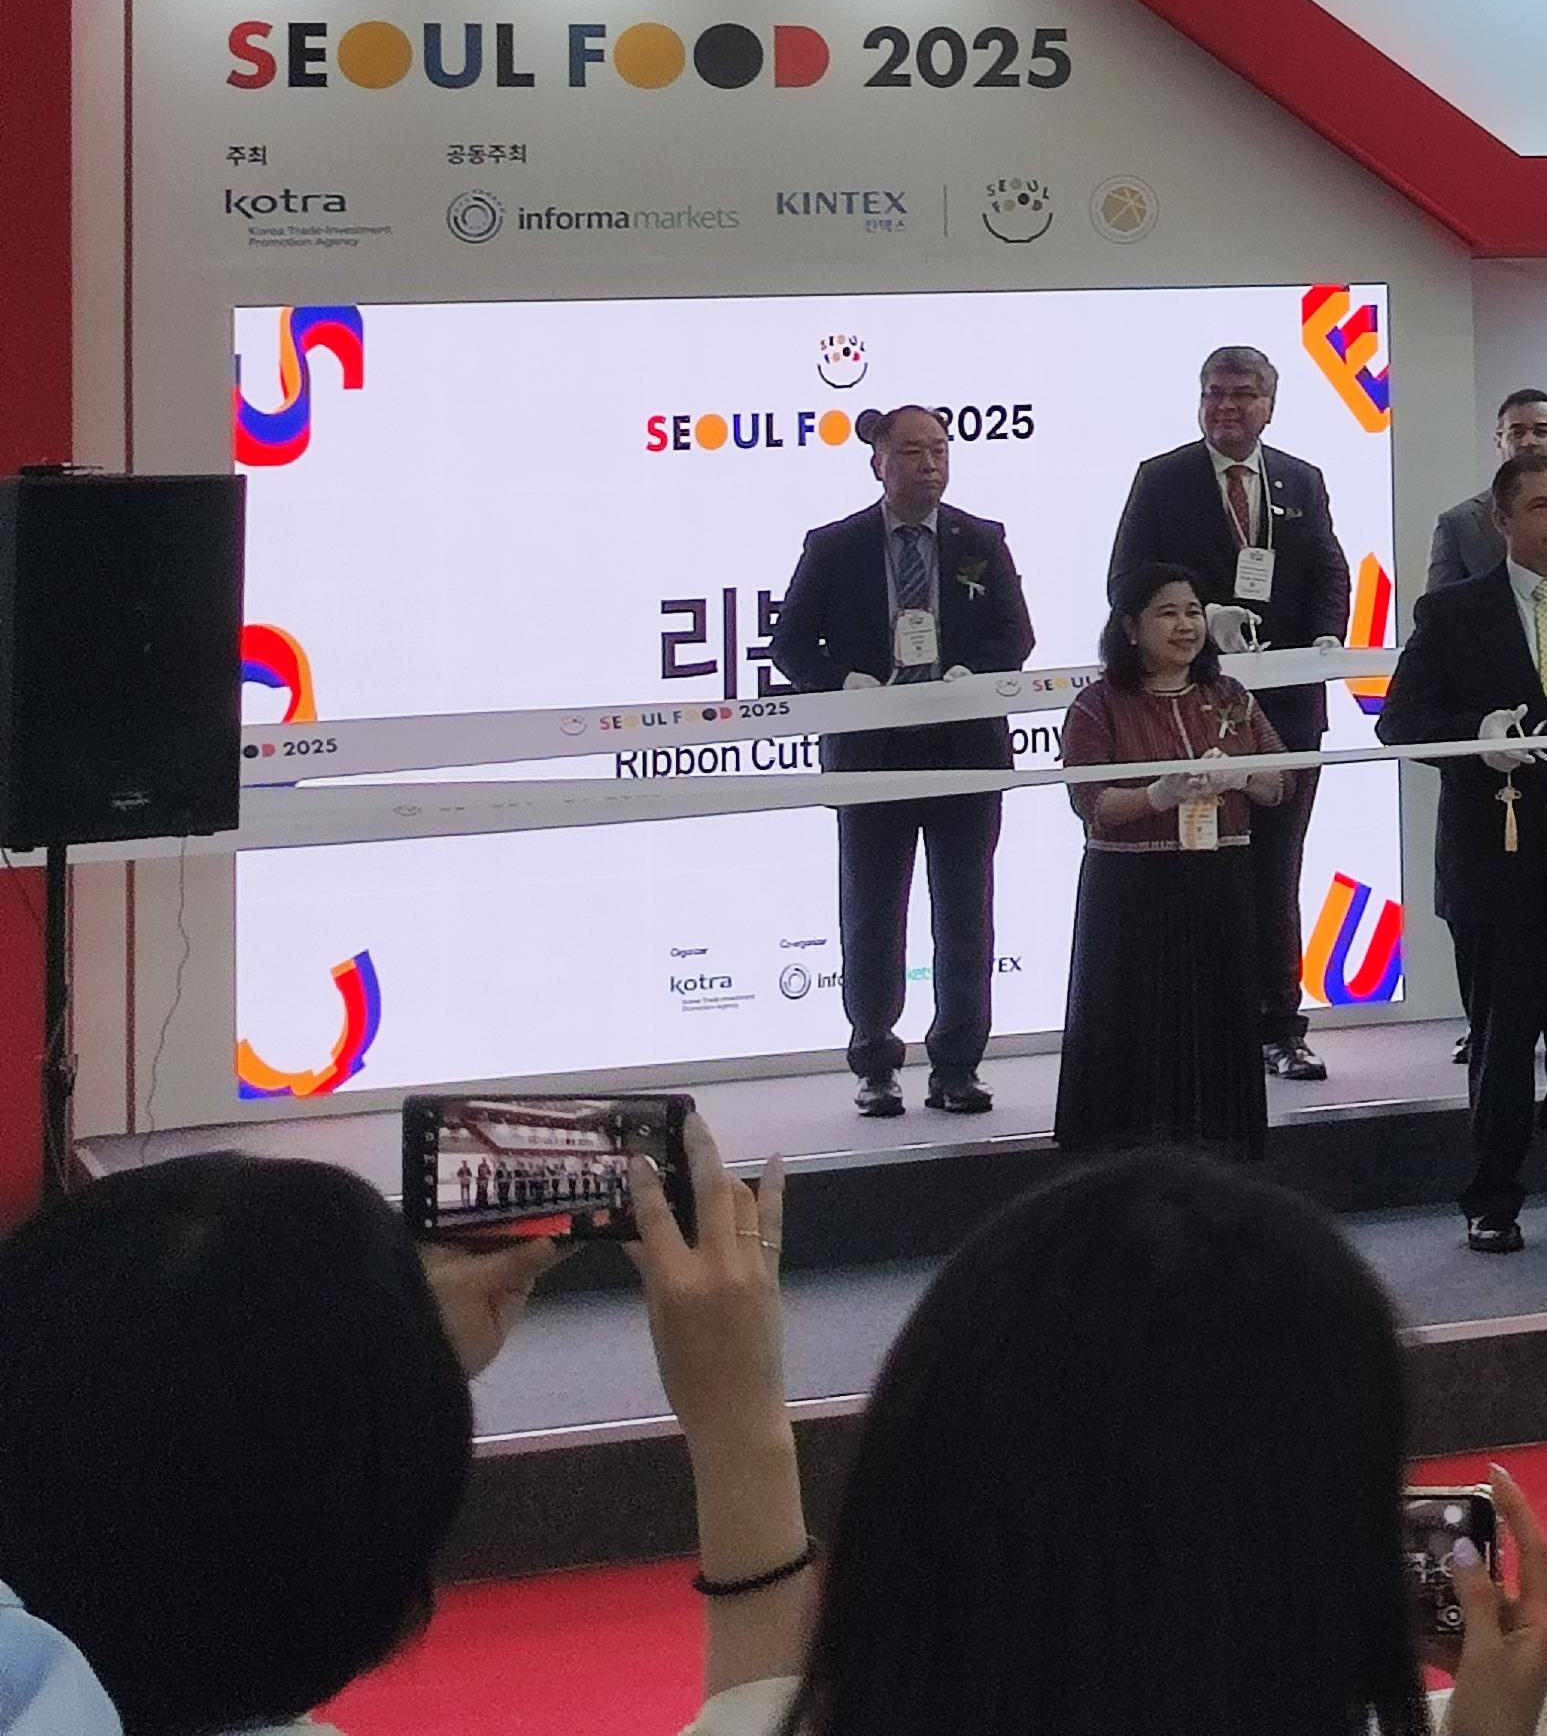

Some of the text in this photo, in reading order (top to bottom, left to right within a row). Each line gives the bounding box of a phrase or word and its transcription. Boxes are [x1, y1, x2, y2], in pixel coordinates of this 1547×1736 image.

[227, 20, 1071, 89] SEOUL FOOD 2025
[226, 145, 267, 165] 주최
[447, 144, 527, 165] 공동주최
[225, 189, 347, 219] kotra
[776, 191, 907, 215] KINTEX
[646, 411, 784, 452] SEOUL
[599, 712, 667, 731] SEOUL
[673, 706, 733, 725] FOOD
[739, 701, 790, 719] 2025
[283, 738, 338, 758] 2025
[670, 973, 733, 995] kotra
